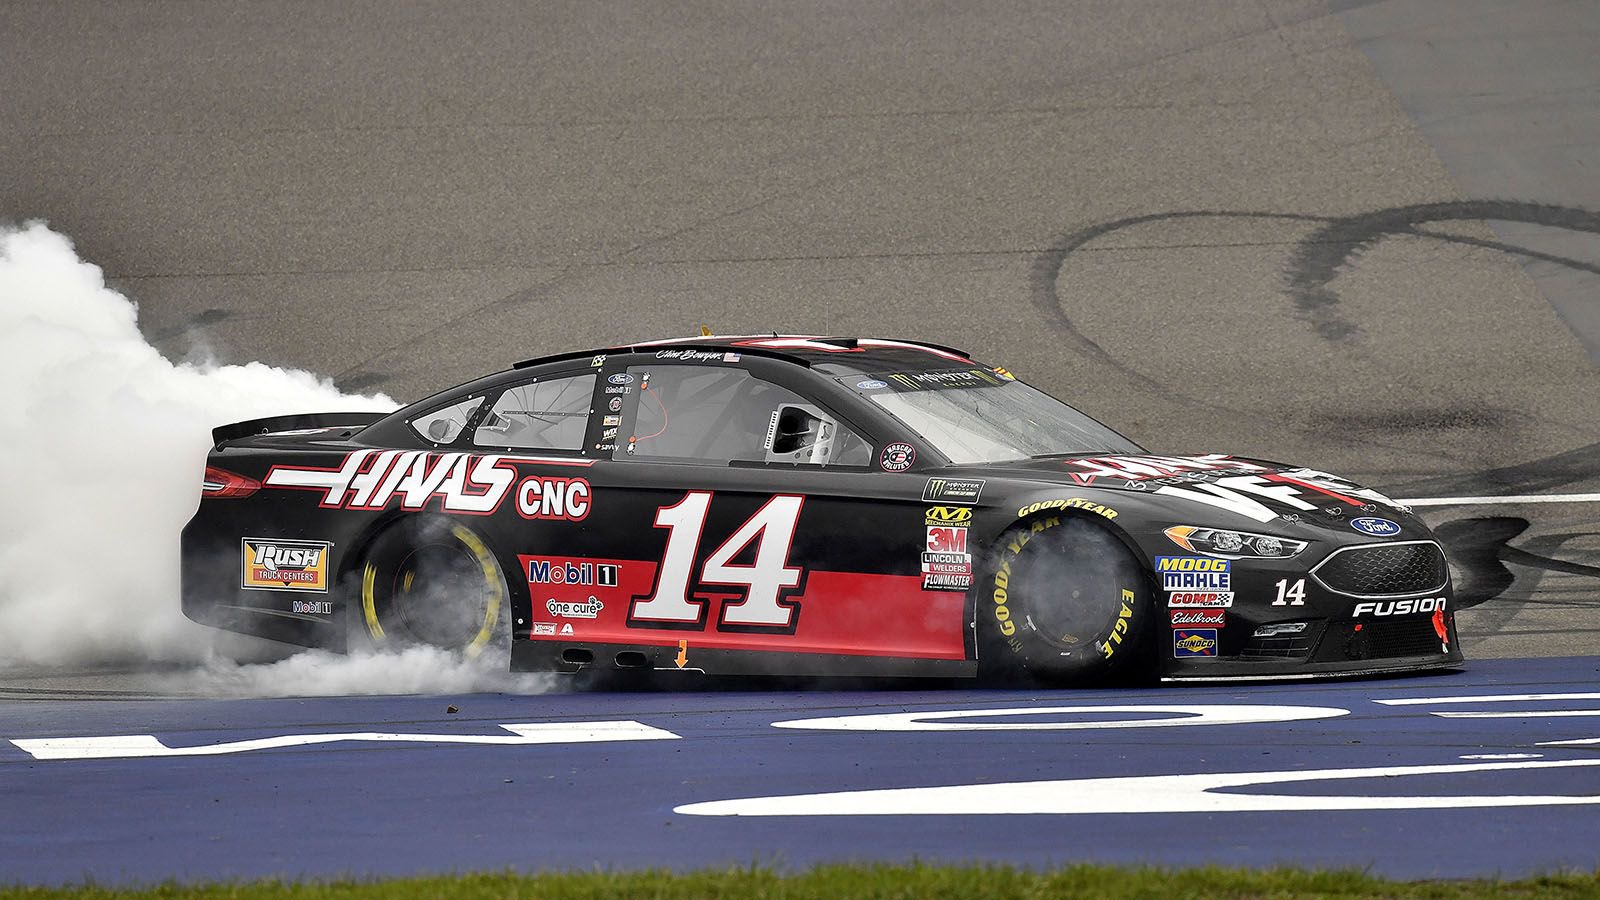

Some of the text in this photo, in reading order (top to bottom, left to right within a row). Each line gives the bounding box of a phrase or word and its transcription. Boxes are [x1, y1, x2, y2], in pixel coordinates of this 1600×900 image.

[262, 450, 591, 521] HAAS CNC
[1017, 497, 1119, 520] GOODYEAR
[924, 518, 971, 528] MECHANIX WEAR
[1358, 518, 1395, 533] Ford
[928, 528, 967, 553] 3M
[253, 544, 321, 572] RUSH
[630, 490, 806, 630] 14
[924, 554, 963, 564] LINCOLN
[1158, 557, 1228, 572] MOOG
[258, 570, 314, 581] TRUCK CENTERS
[529, 560, 593, 585] Mobil
[932, 564, 967, 573] WELDERS
[923, 574, 970, 589] FLOWMASTER
[1165, 572, 1229, 588] MAHLE
[1171, 593, 1218, 605] COMP
[1271, 578, 1307, 607] 14
[292, 600, 322, 614] Mobil
[548, 602, 597, 614] one cure
[1351, 597, 1447, 618] FUSION
[1101, 588, 1135, 660] EAGLE
[1171, 612, 1225, 624] Edelbrock
[1177, 639, 1215, 648] SUNOCO
